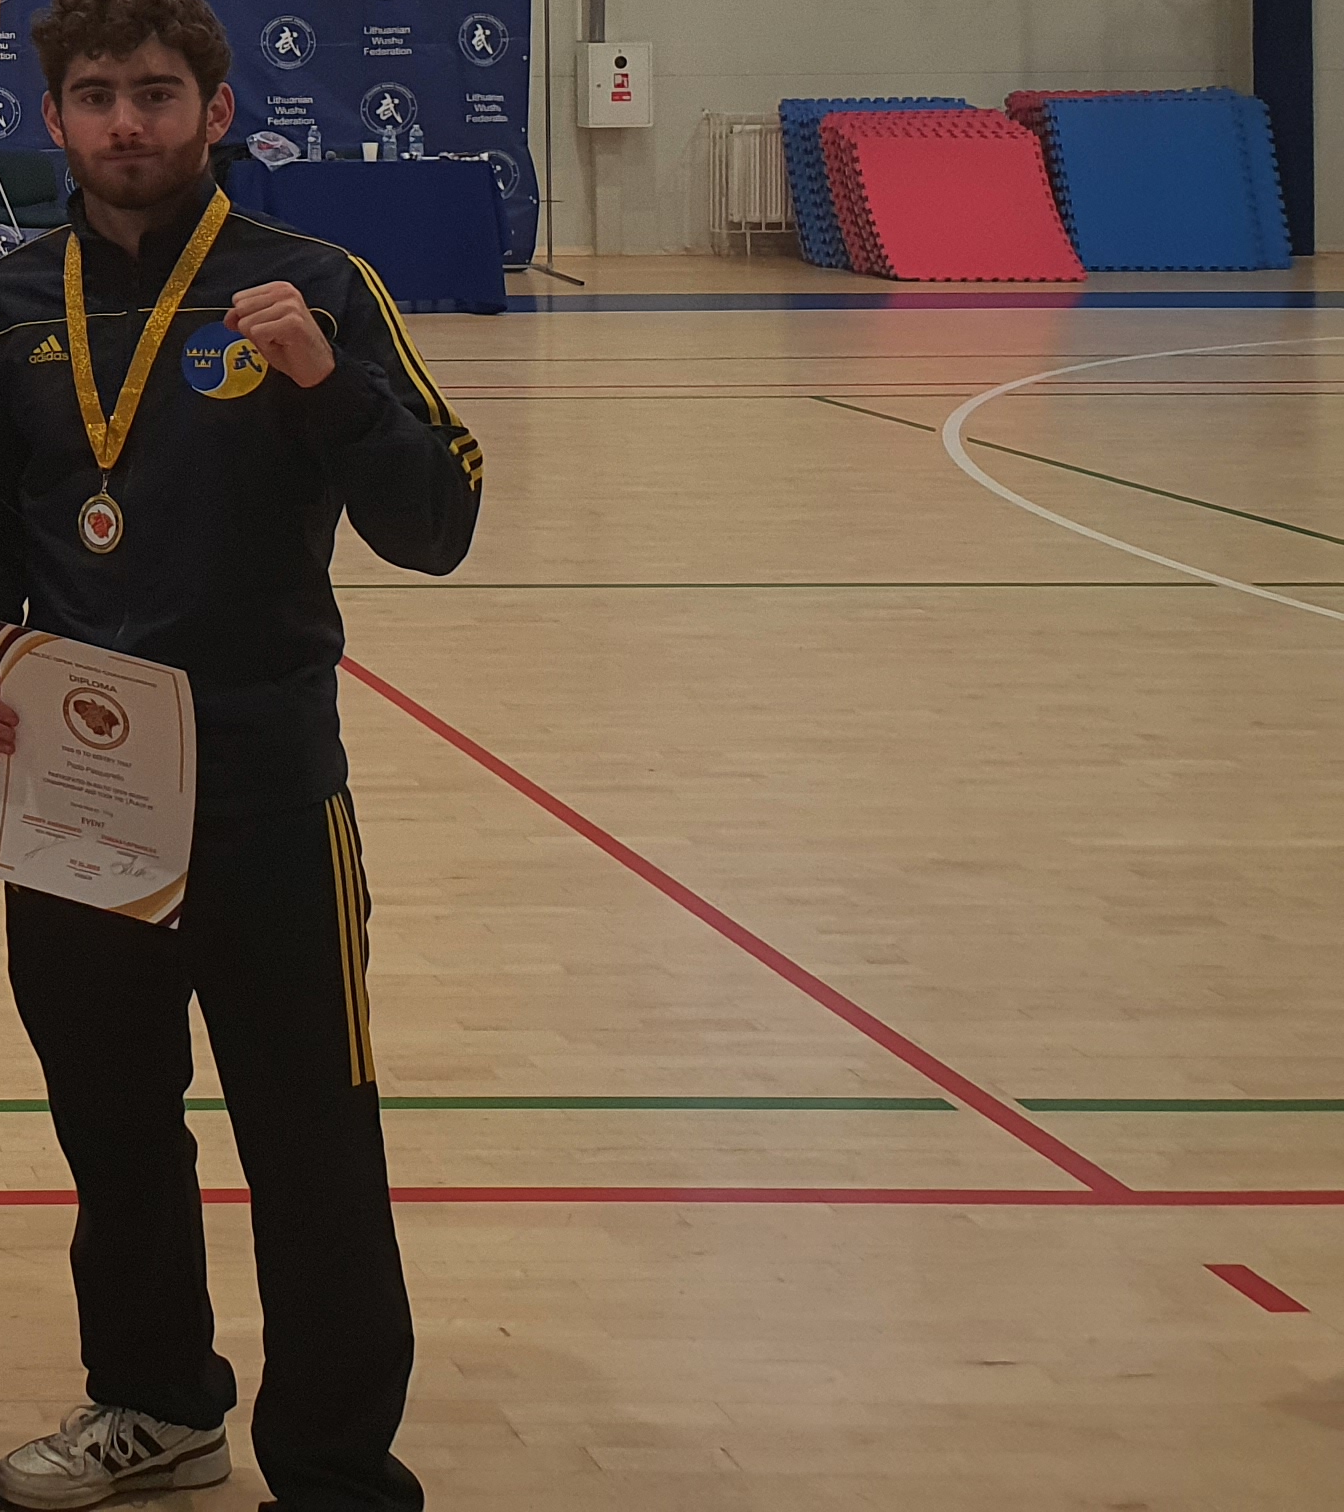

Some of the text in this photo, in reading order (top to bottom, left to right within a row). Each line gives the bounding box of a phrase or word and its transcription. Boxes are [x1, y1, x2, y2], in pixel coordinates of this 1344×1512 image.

[363, 25, 411, 35] Lithuanian
[371, 36, 404, 45] Wushu
[363, 47, 412, 56] Federation
[267, 95, 314, 105] Lithuanian
[274, 106, 307, 115] Wushu
[267, 117, 315, 126] Federation
[28, 351, 70, 365] adidas
[69, 673, 118, 694] DIPLOMA
[81, 816, 105, 829] EVENT
